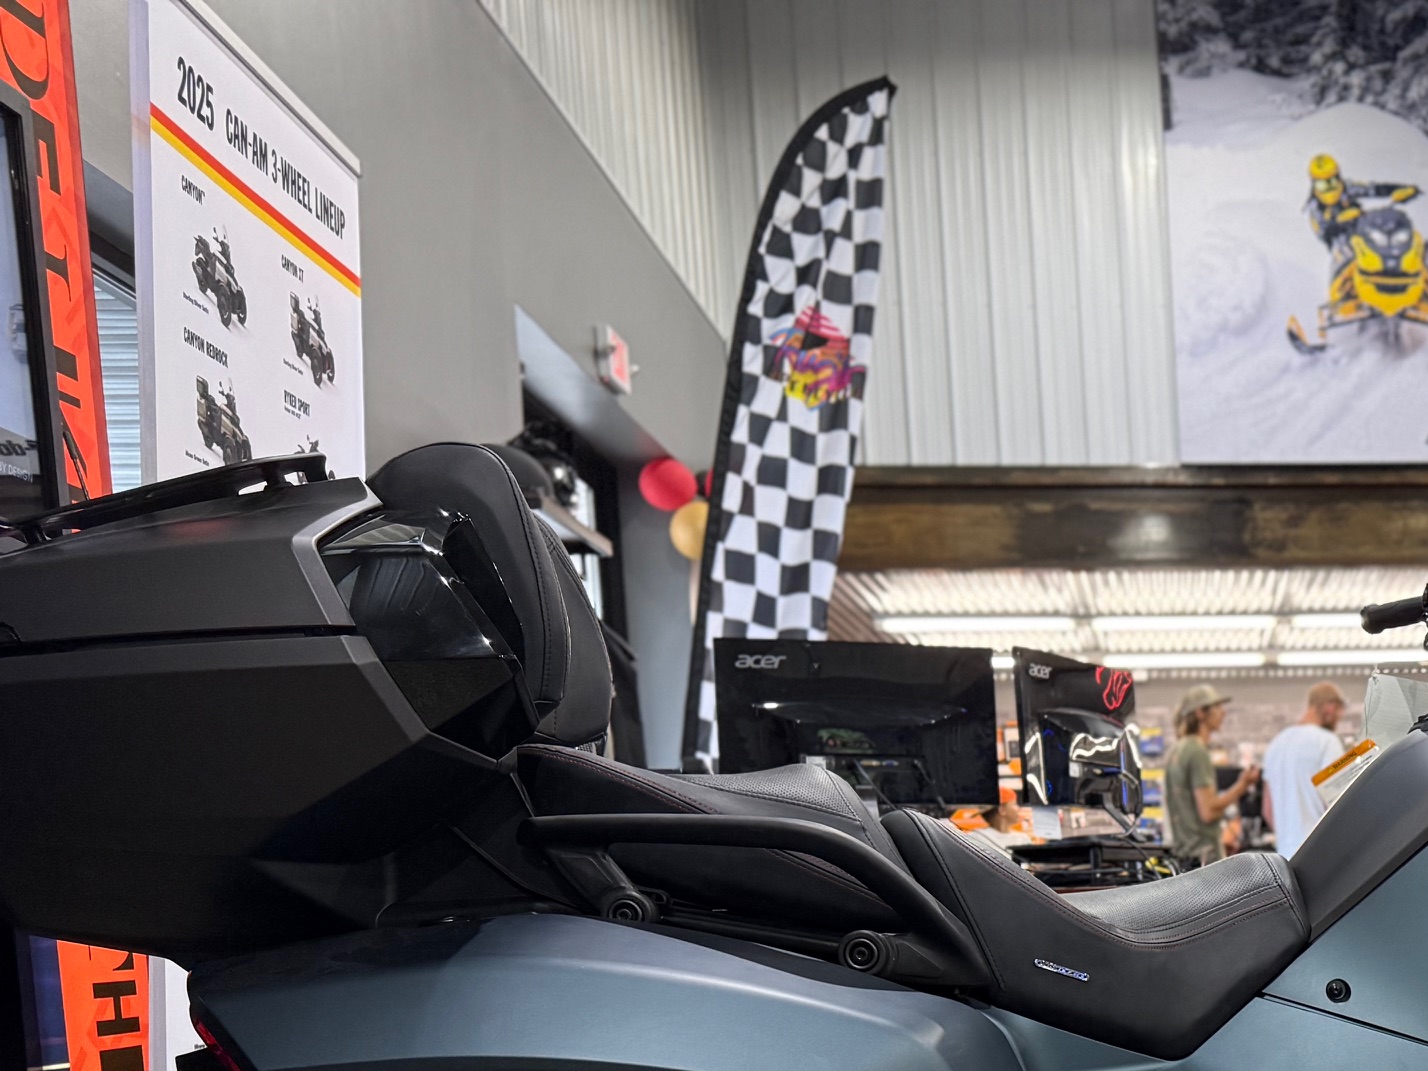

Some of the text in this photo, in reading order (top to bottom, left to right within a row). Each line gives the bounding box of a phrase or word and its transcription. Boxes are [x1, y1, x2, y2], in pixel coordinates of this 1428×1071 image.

[177, 56, 346, 240] 2025 CAN-AM 3-WHEEL LINEUP
[281, 254, 298, 279] CANYON
[183, 326, 229, 368] CANYON REDROCK
[735, 653, 787, 669] acer
[1028, 662, 1053, 680] acer
